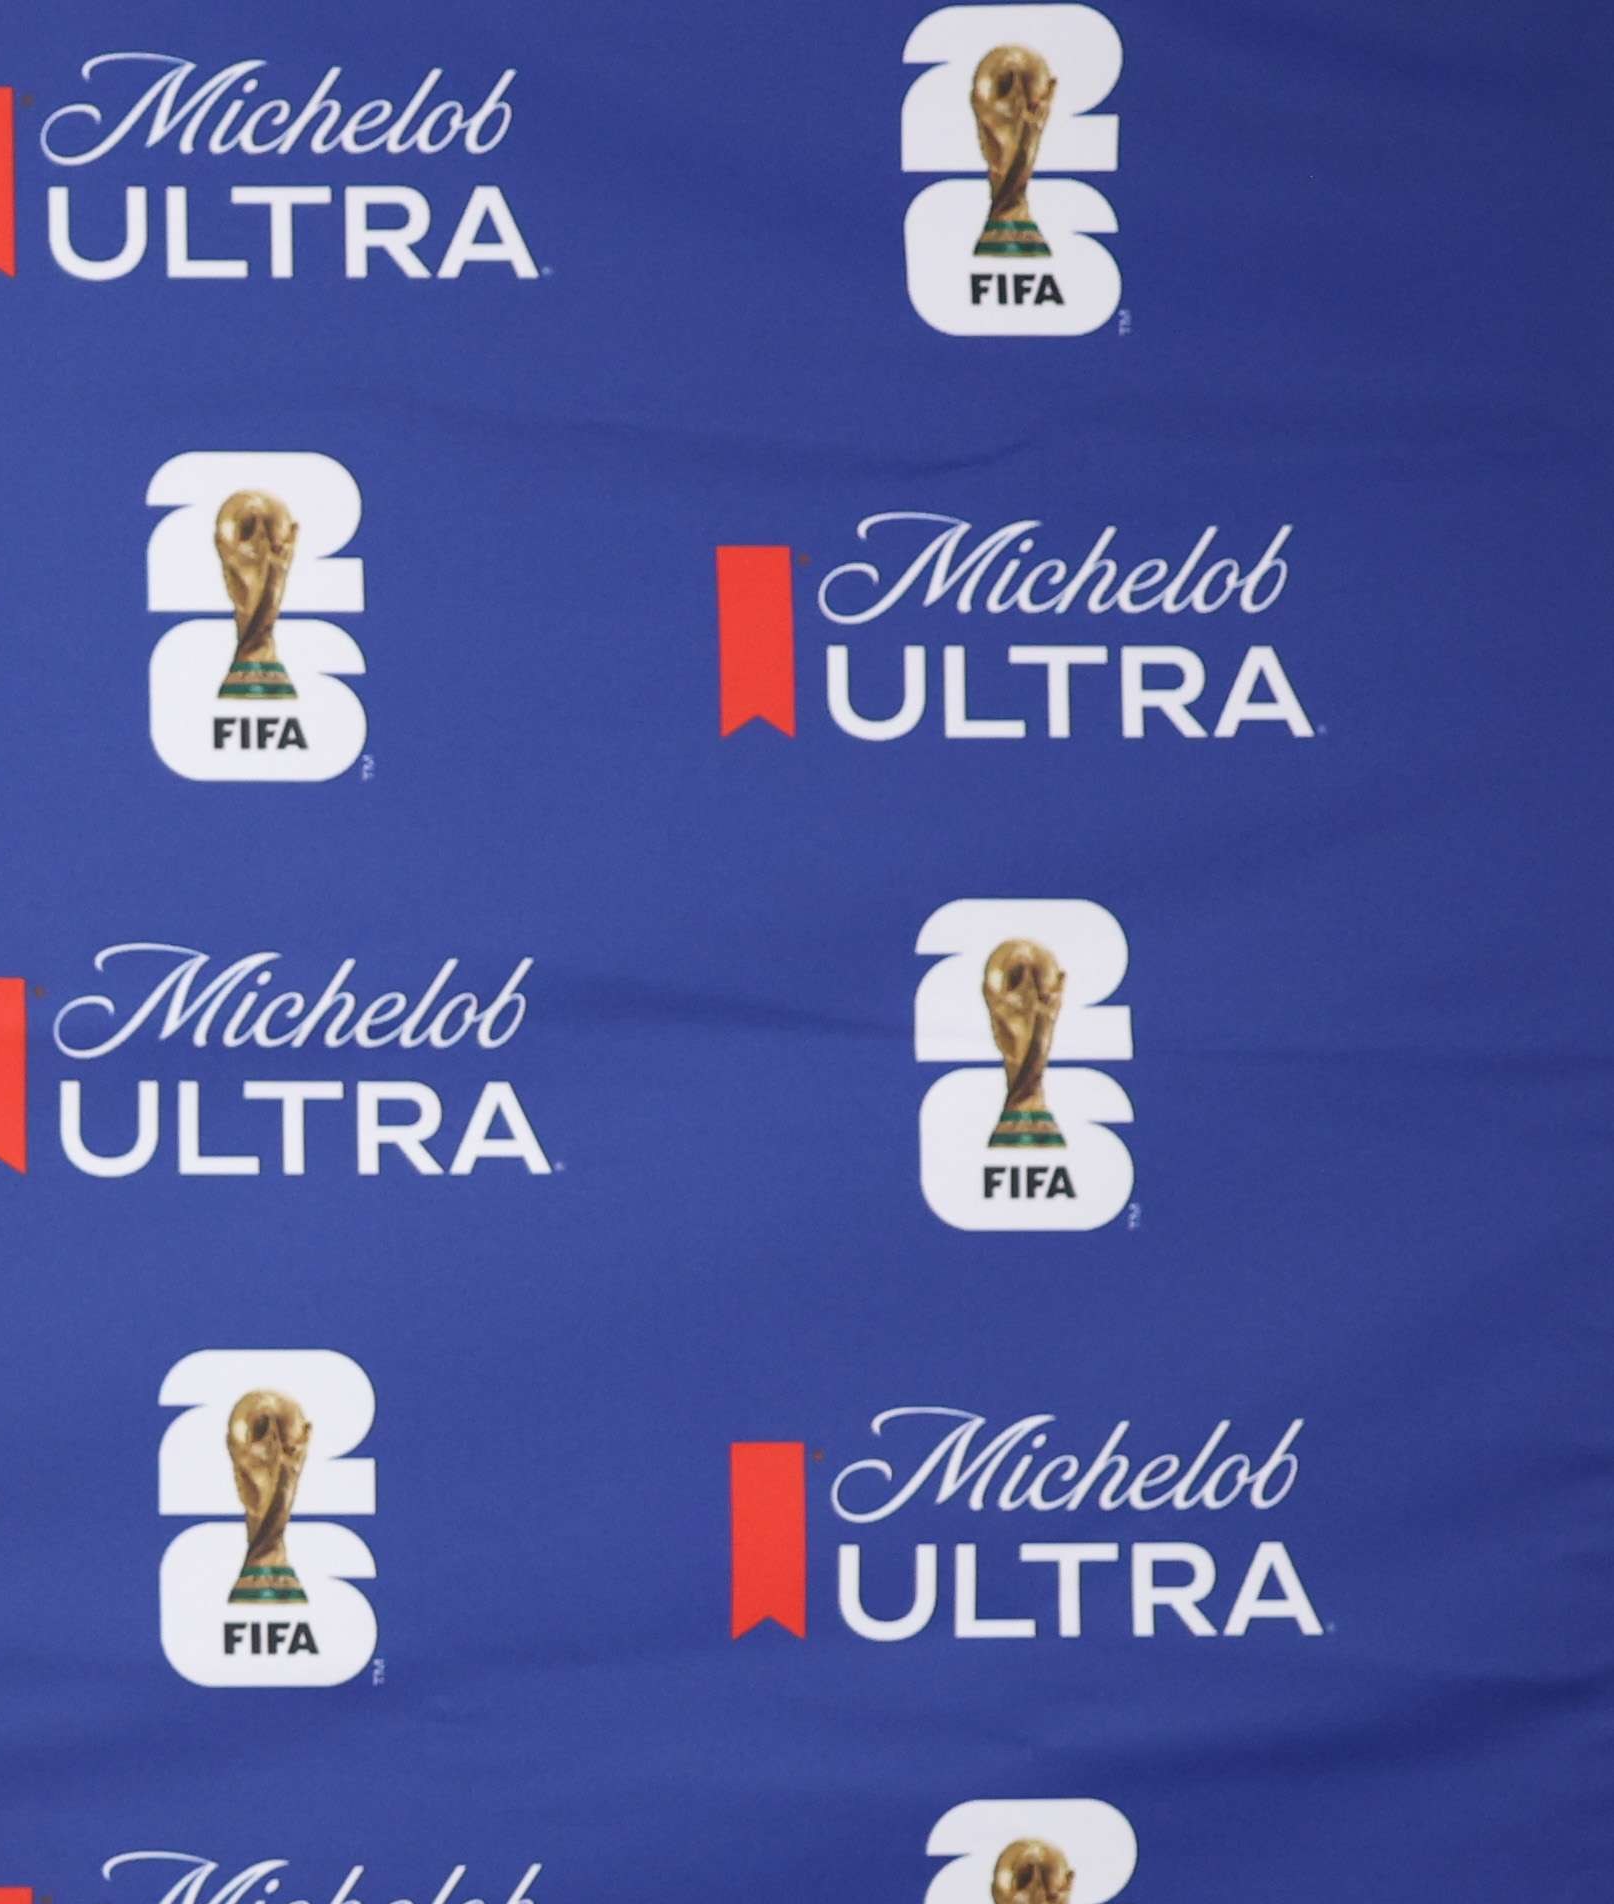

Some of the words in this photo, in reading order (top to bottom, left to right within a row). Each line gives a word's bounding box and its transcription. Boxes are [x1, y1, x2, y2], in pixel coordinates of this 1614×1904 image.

[40, 52, 516, 167] Michelob
[47, 185, 540, 282] ULTRA
[970, 273, 1064, 305] FIFA
[817, 511, 1292, 625] Michelob
[213, 717, 308, 750] FIFA
[826, 644, 1315, 742] ULTRA
[53, 942, 534, 1059] Michelob
[59, 1080, 552, 1178] ULTRA
[983, 1166, 1076, 1199] FIFA
[830, 1406, 1304, 1524] Michelob
[223, 1622, 319, 1655] FIFA
[837, 1541, 1324, 1642] ULTRA
